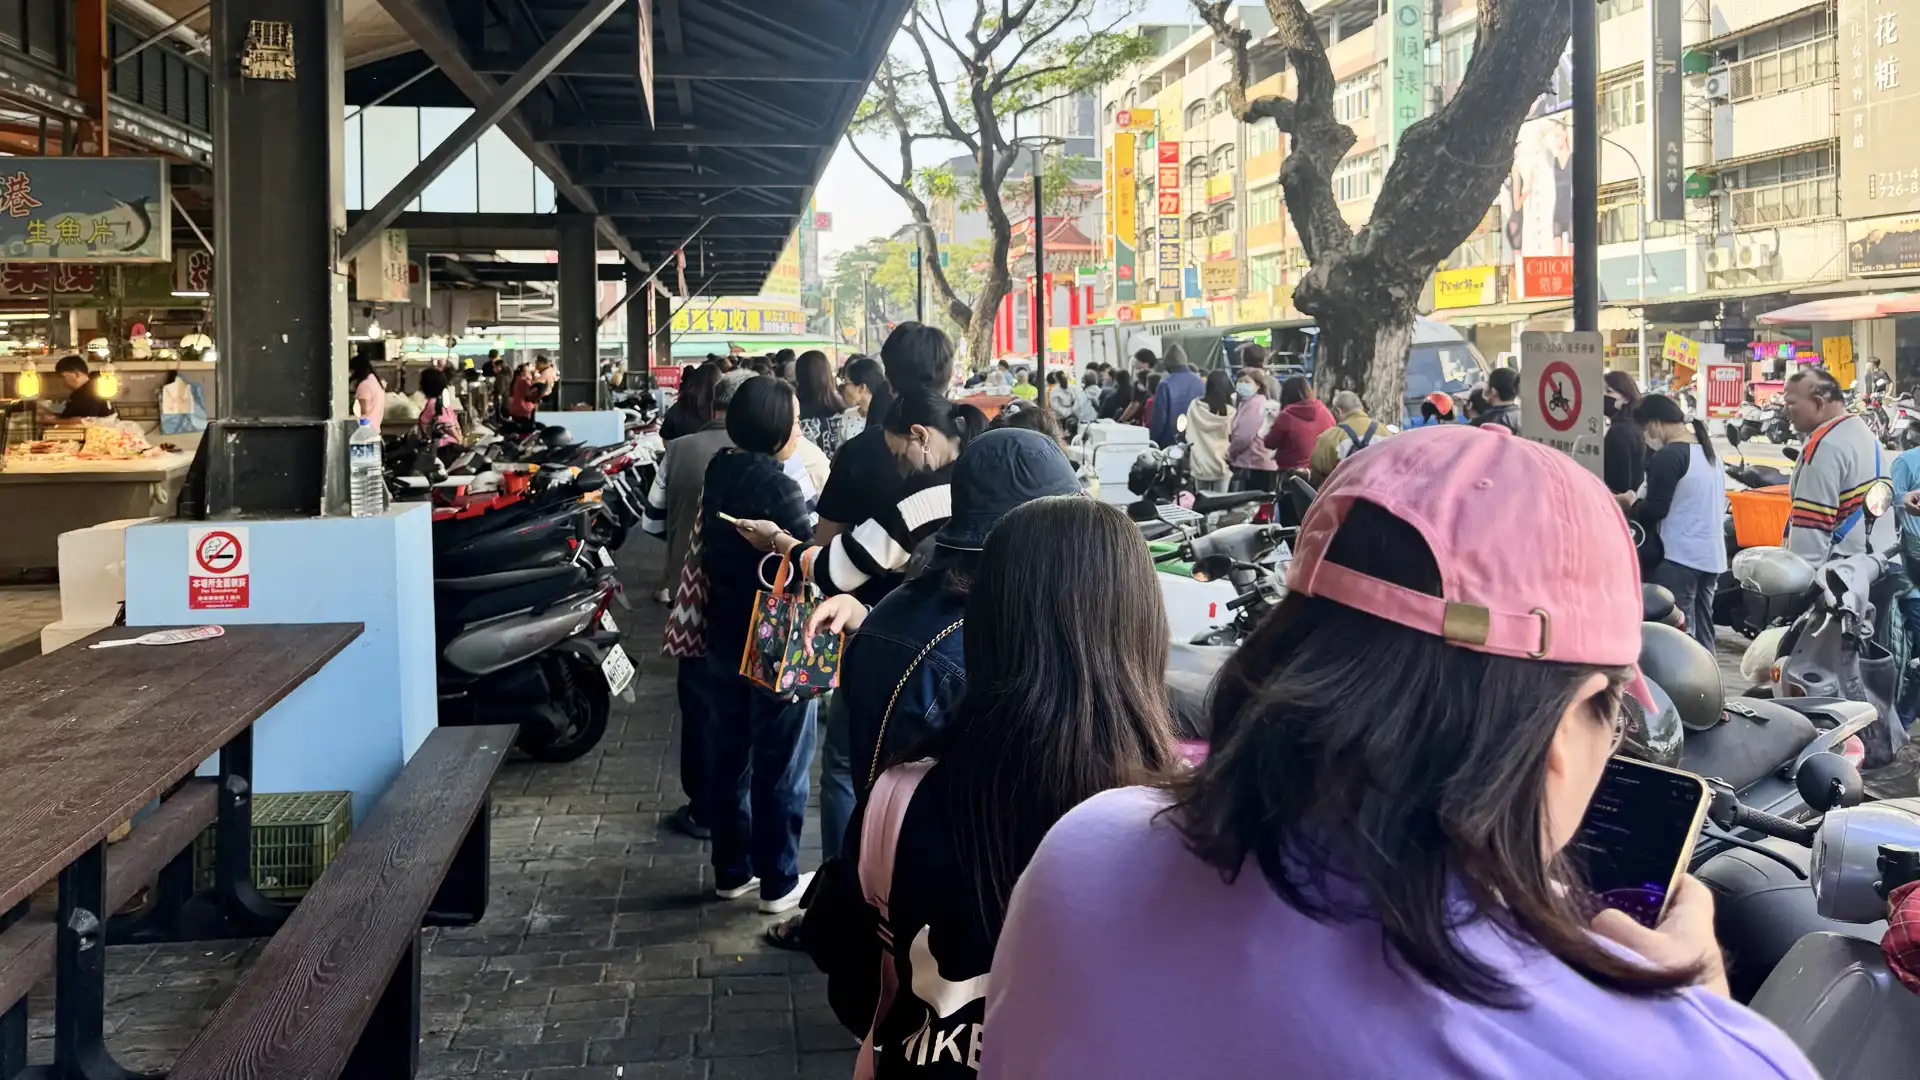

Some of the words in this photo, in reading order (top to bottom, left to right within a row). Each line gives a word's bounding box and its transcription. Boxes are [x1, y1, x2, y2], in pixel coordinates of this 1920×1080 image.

[1874, 0, 1900, 92] 花粧
[24, 215, 114, 245] 生魚片
